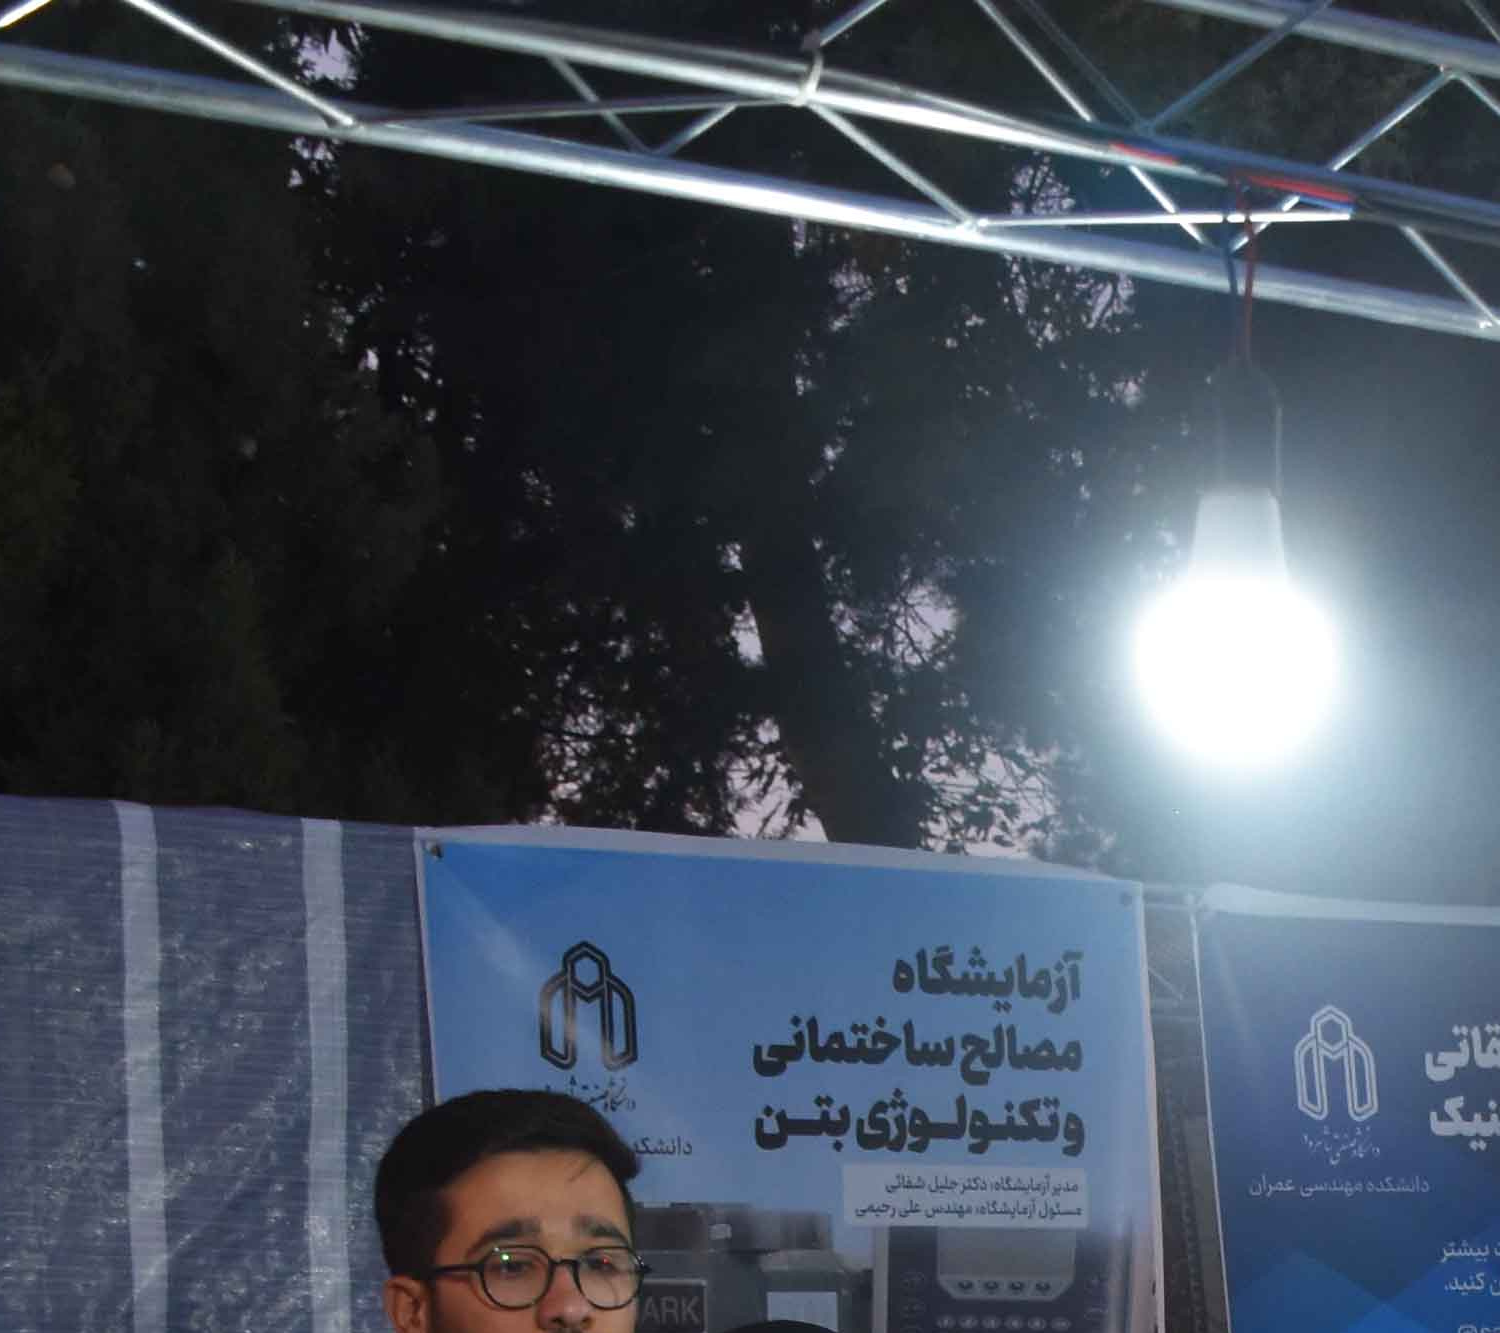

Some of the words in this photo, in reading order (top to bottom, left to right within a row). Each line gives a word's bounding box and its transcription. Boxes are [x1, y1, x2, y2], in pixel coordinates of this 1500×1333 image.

[891, 944, 1084, 1015] آزمایشگاه
[752, 1013, 956, 1077] ساختمانی
[960, 1020, 1084, 1087] مصالح
[753, 1094, 851, 1152] بتن
[1248, 1172, 1296, 1198] عمران
[1299, 1176, 1364, 1198] مهندسی
[1366, 1174, 1431, 1194] دانشکده
[1439, 1237, 1490, 1264] بیشتر
